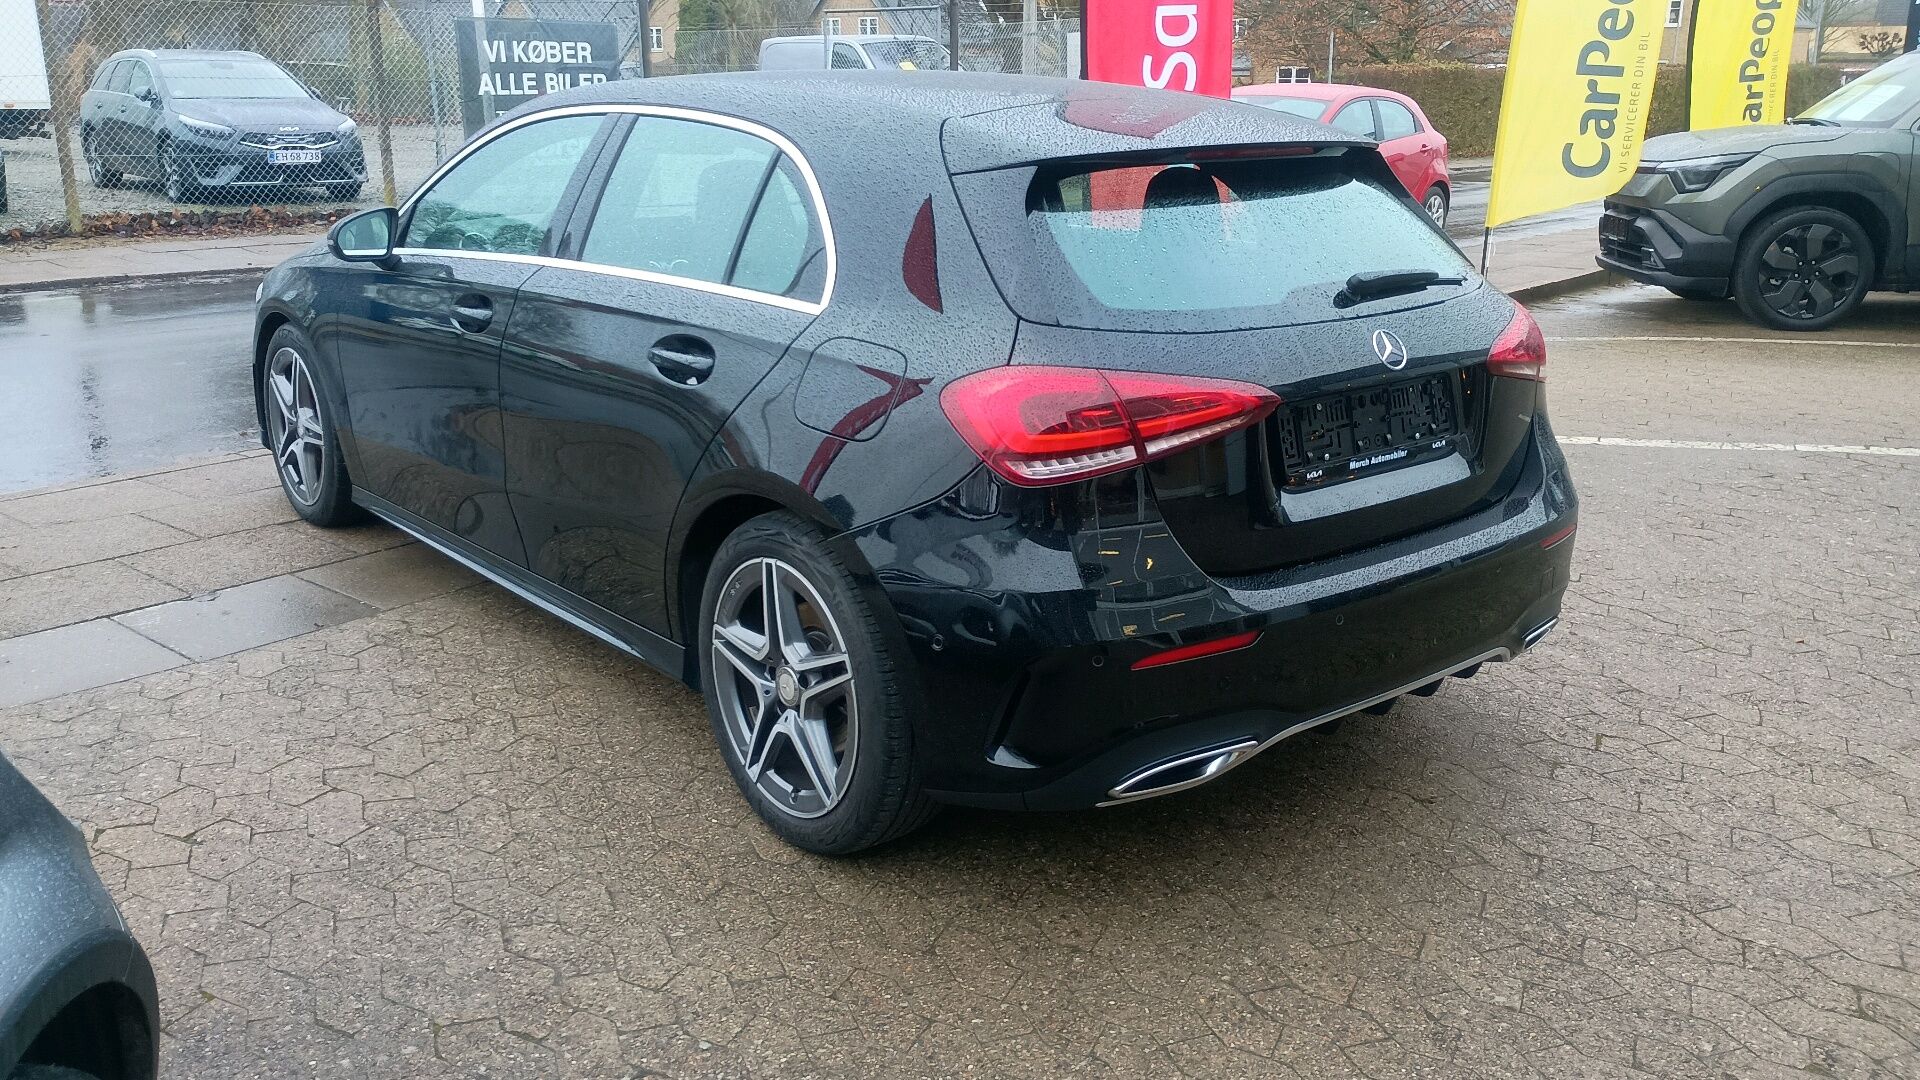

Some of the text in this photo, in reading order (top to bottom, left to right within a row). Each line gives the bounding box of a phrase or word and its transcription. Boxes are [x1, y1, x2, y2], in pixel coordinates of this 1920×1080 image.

[483, 40, 593, 64] VI KØBER
[478, 73, 539, 95] ALLE
[1561, 0, 1635, 179] CarPe
[1618, 31, 1651, 173] VI SERVICERER DIN BIL
[304, 152, 320, 160] 738
